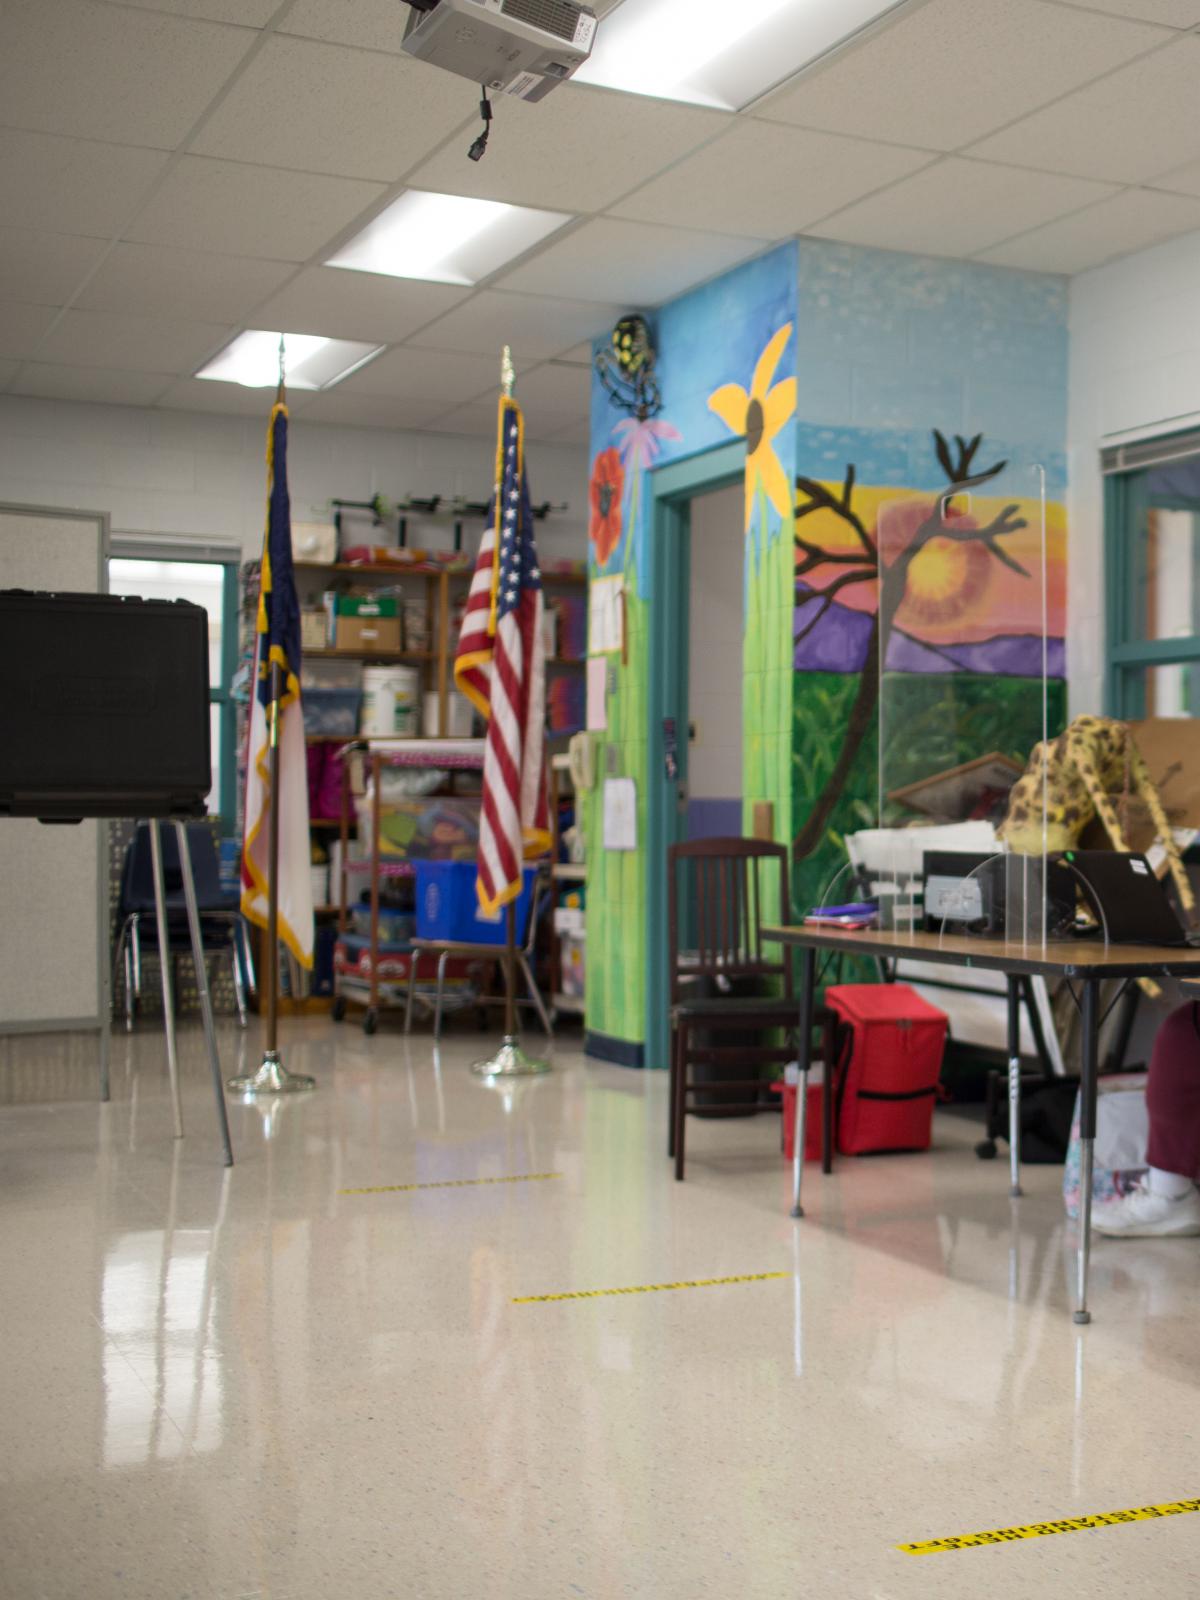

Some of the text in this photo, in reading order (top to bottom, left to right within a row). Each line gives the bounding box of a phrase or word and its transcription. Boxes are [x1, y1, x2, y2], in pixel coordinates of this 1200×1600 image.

[975, 1506, 1159, 1539] DISTANCING
[1037, 1516, 1136, 1535] STAND
[909, 1537, 961, 1551] 6FT
[944, 1533, 1025, 1551] HERE
